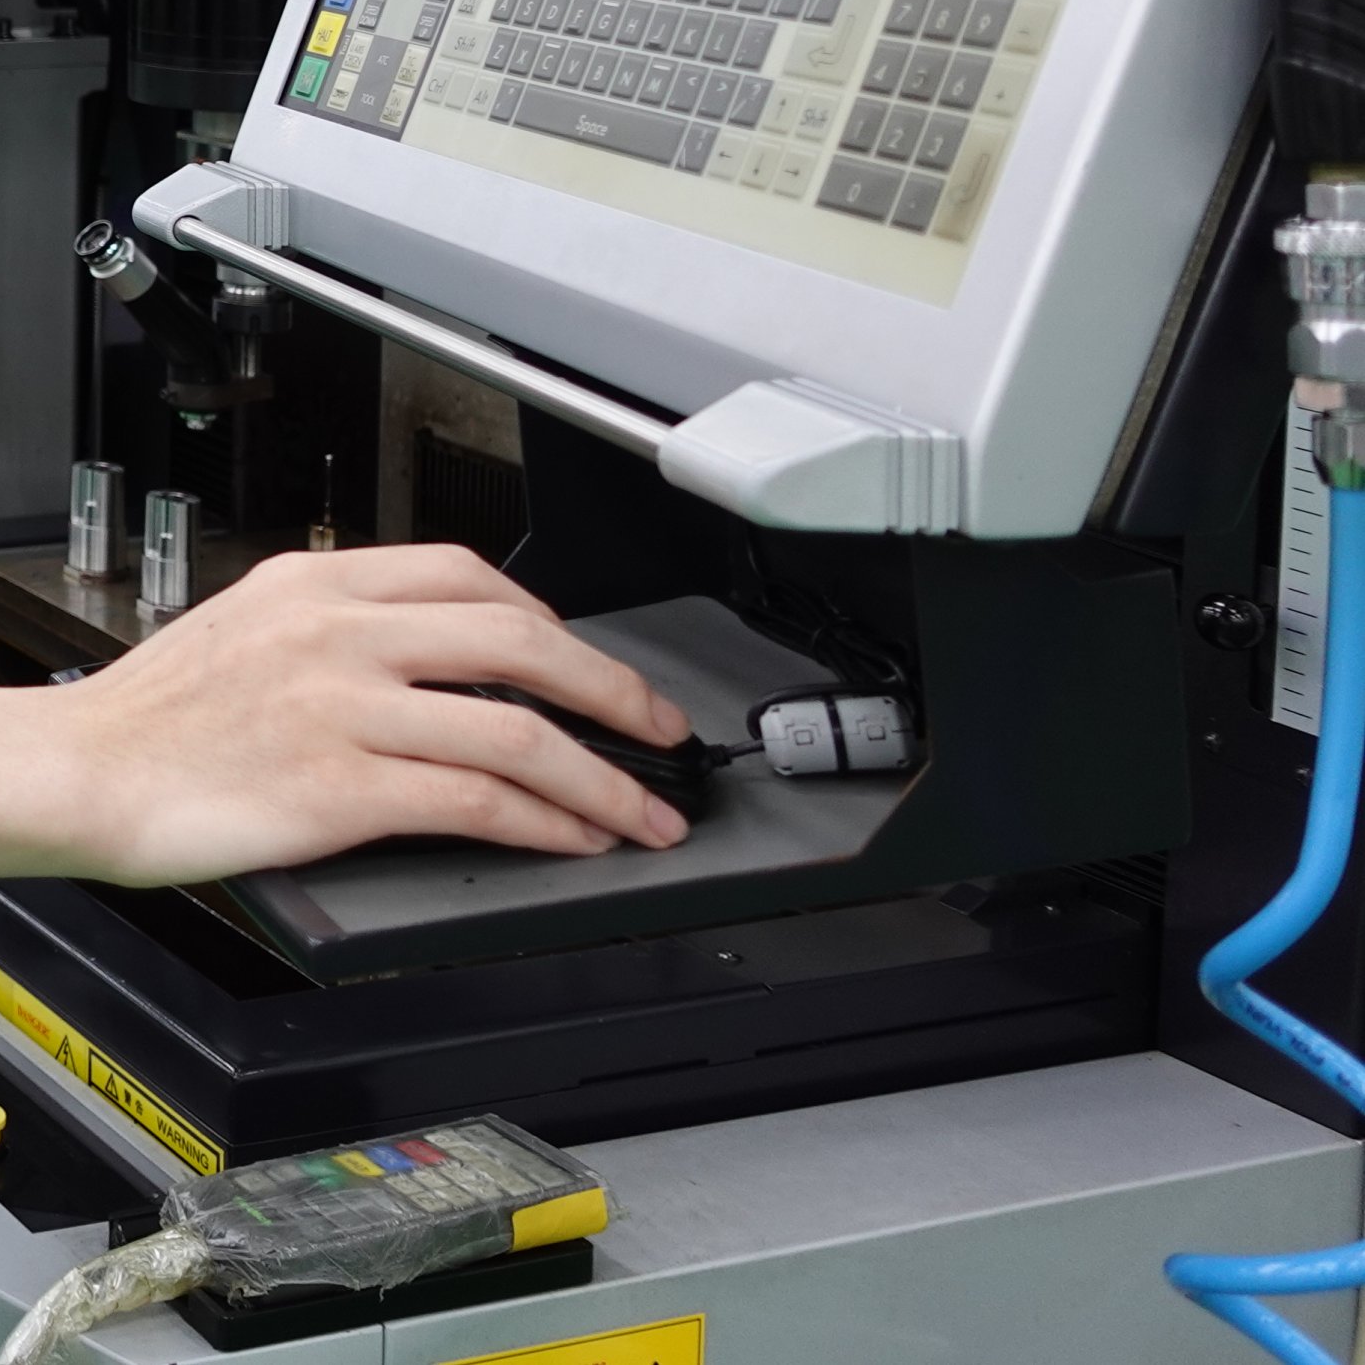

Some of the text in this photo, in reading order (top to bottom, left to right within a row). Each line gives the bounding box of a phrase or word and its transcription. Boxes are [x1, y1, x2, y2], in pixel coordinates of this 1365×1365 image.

[523, 1, 534, 15] S
[546, 5, 558, 20] D
[895, 4, 913, 23] 7
[572, 9, 584, 25] F
[599, 14, 611, 29] G
[935, 10, 950, 30] 8
[977, 15, 992, 34] 9
[624, 19, 639, 33] H
[651, 23, 666, 40] J
[316, 29, 334, 43] HALT
[683, 29, 697, 45] K
[713, 34, 725, 51] L
[454, 37, 476, 52] Shift
[493, 45, 505, 59] Z
[377, 55, 390, 66] ATC
[516, 51, 528, 65] X
[542, 55, 554, 70] C
[569, 60, 580, 73] V
[593, 65, 605, 81] B
[874, 65, 887, 81] 4
[428, 78, 447, 94] Ctrl
[620, 71, 633, 86] N
[647, 78, 662, 93] M
[952, 78, 967, 97] 6
[473, 90, 488, 104] Alt
[575, 115, 608, 136] Space
[888, 128, 904, 149] 2
[928, 137, 944, 158] 3
[846, 183, 862, 203] 0
[156, 1116, 209, 1170] WARNING
